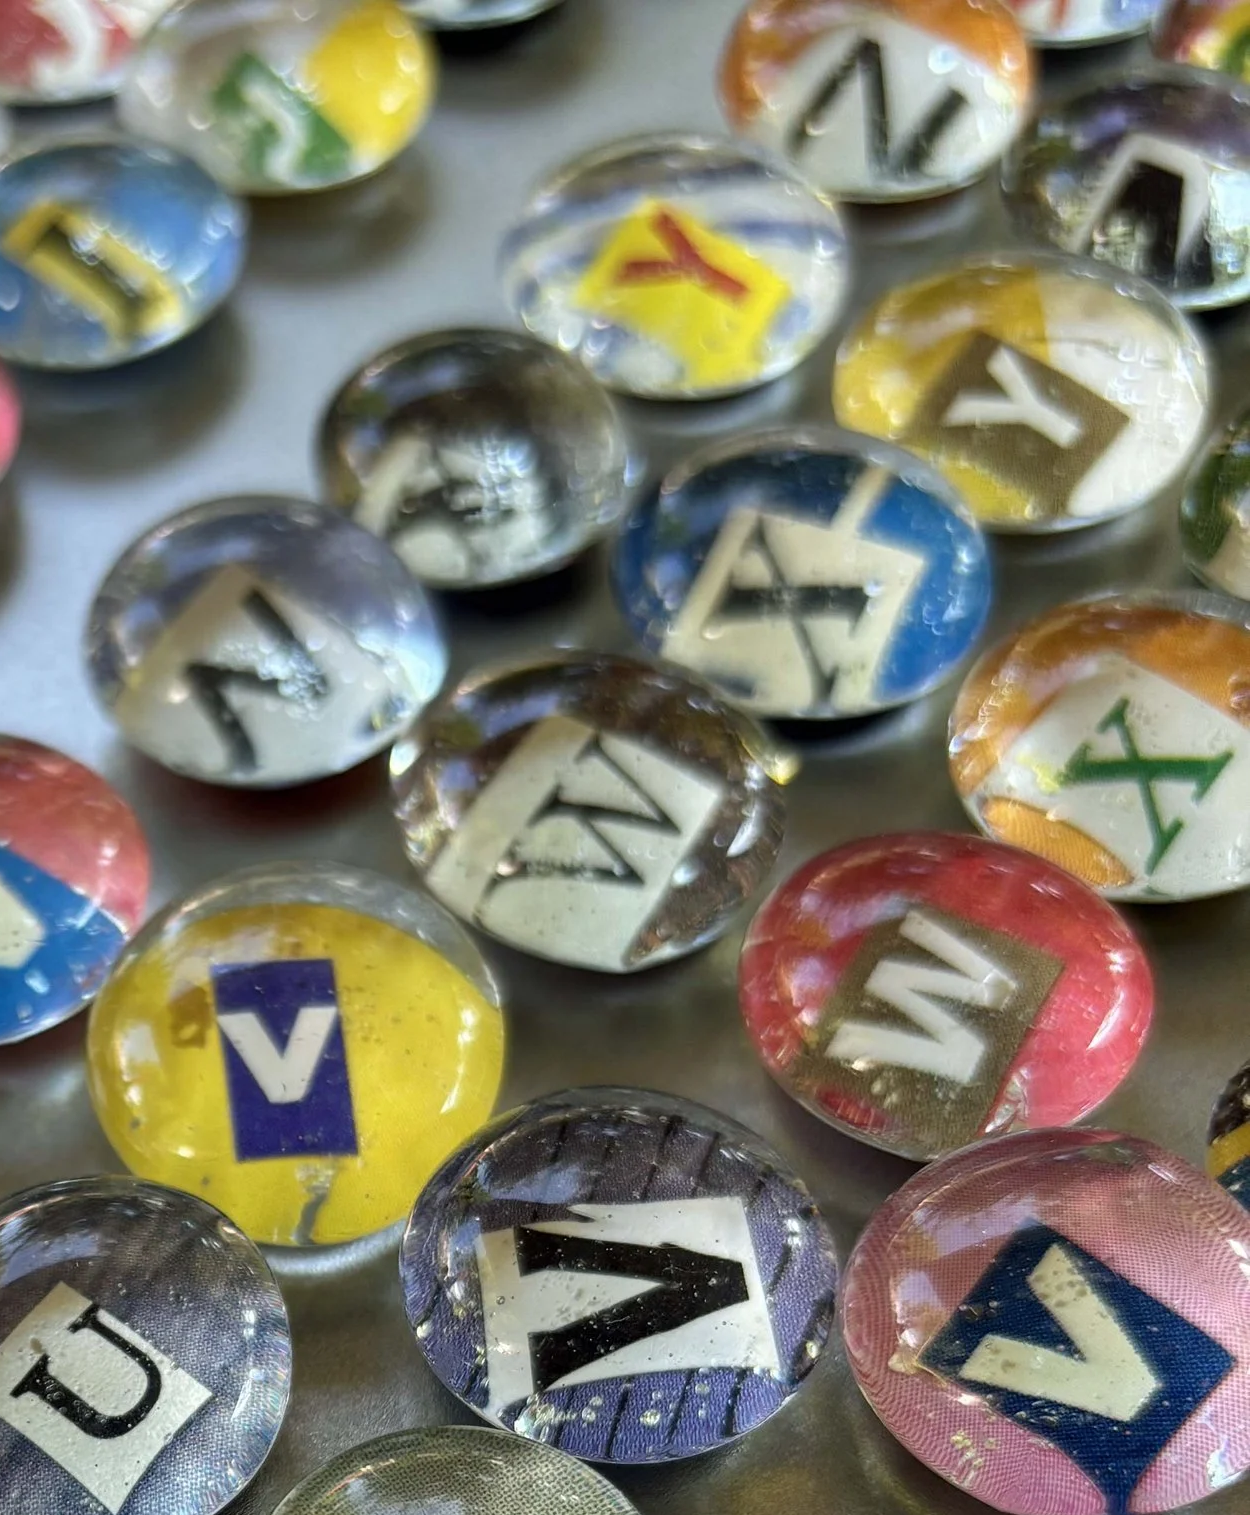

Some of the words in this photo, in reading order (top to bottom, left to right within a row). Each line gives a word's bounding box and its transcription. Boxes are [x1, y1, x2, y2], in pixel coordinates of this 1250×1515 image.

[616, 208, 750, 301] Y
[942, 345, 1081, 449] Y
[1060, 697, 1234, 874] X
